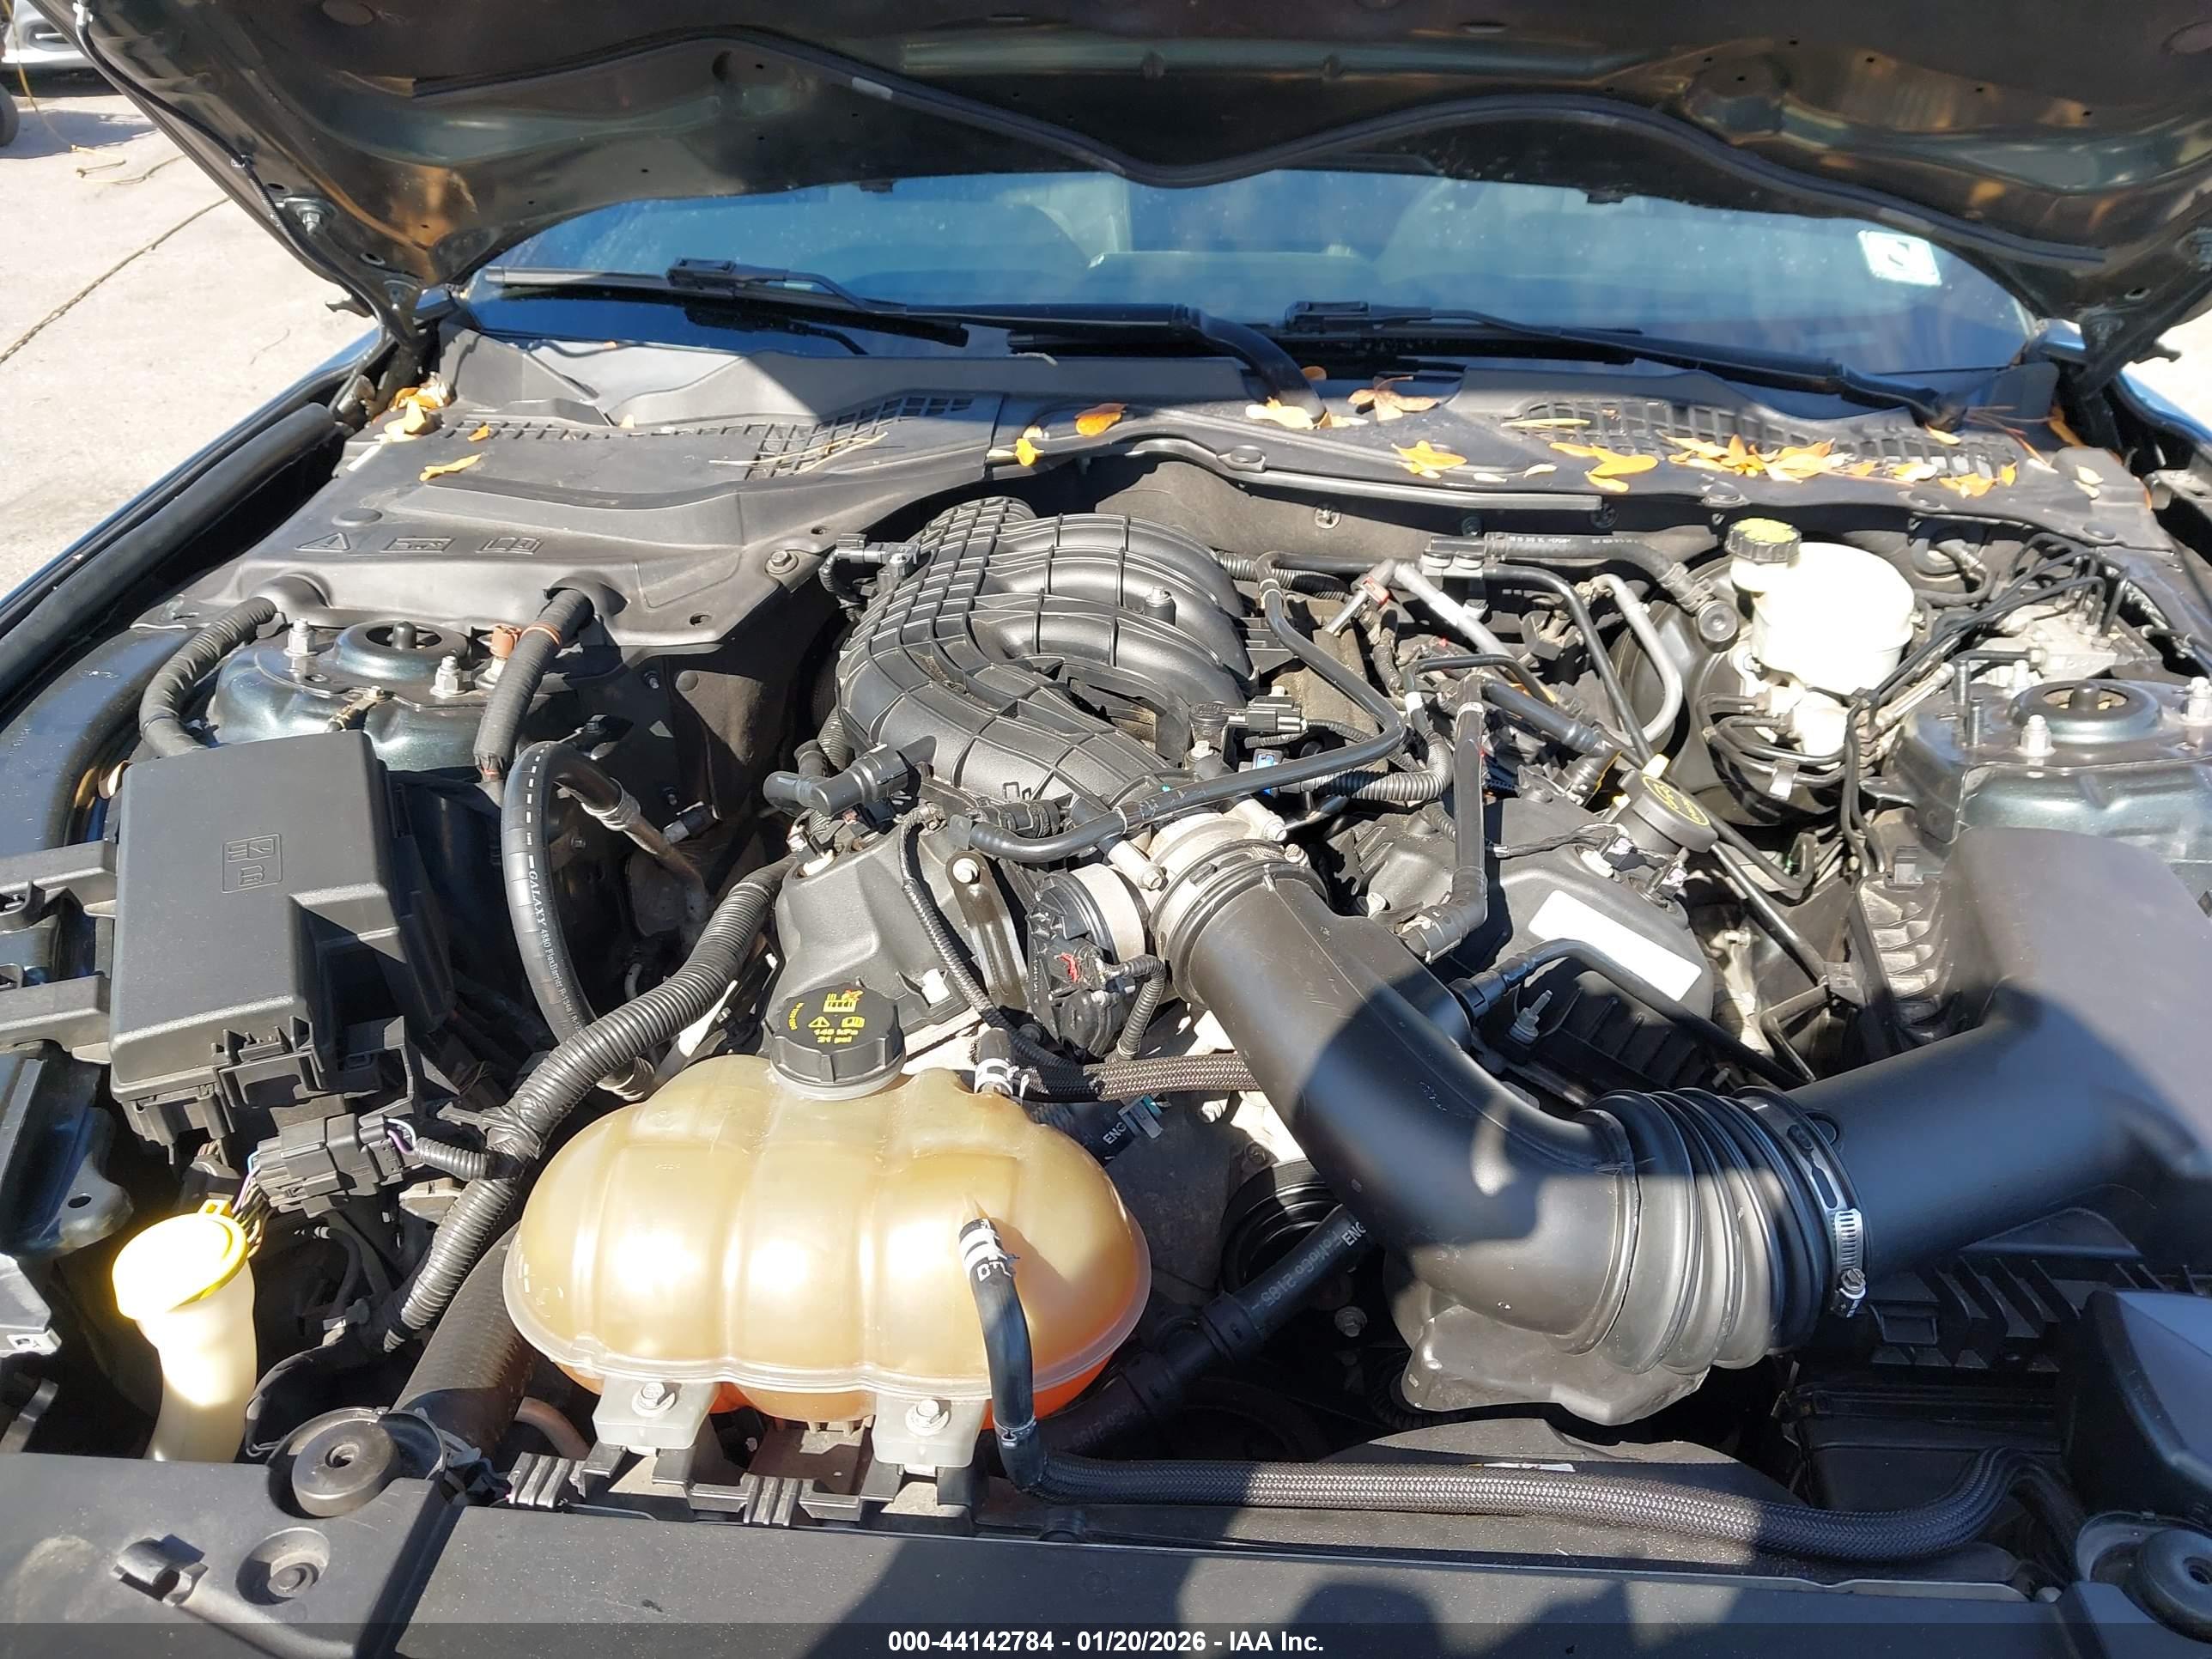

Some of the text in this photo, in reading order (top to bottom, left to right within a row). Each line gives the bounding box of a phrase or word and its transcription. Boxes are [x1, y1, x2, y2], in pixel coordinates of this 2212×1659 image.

[528, 871, 548, 927] GALAXY
[540, 928, 550, 948] 4880
[545, 948, 562, 988] FlexBarrier
[1261, 1273, 1297, 1306] 2185
